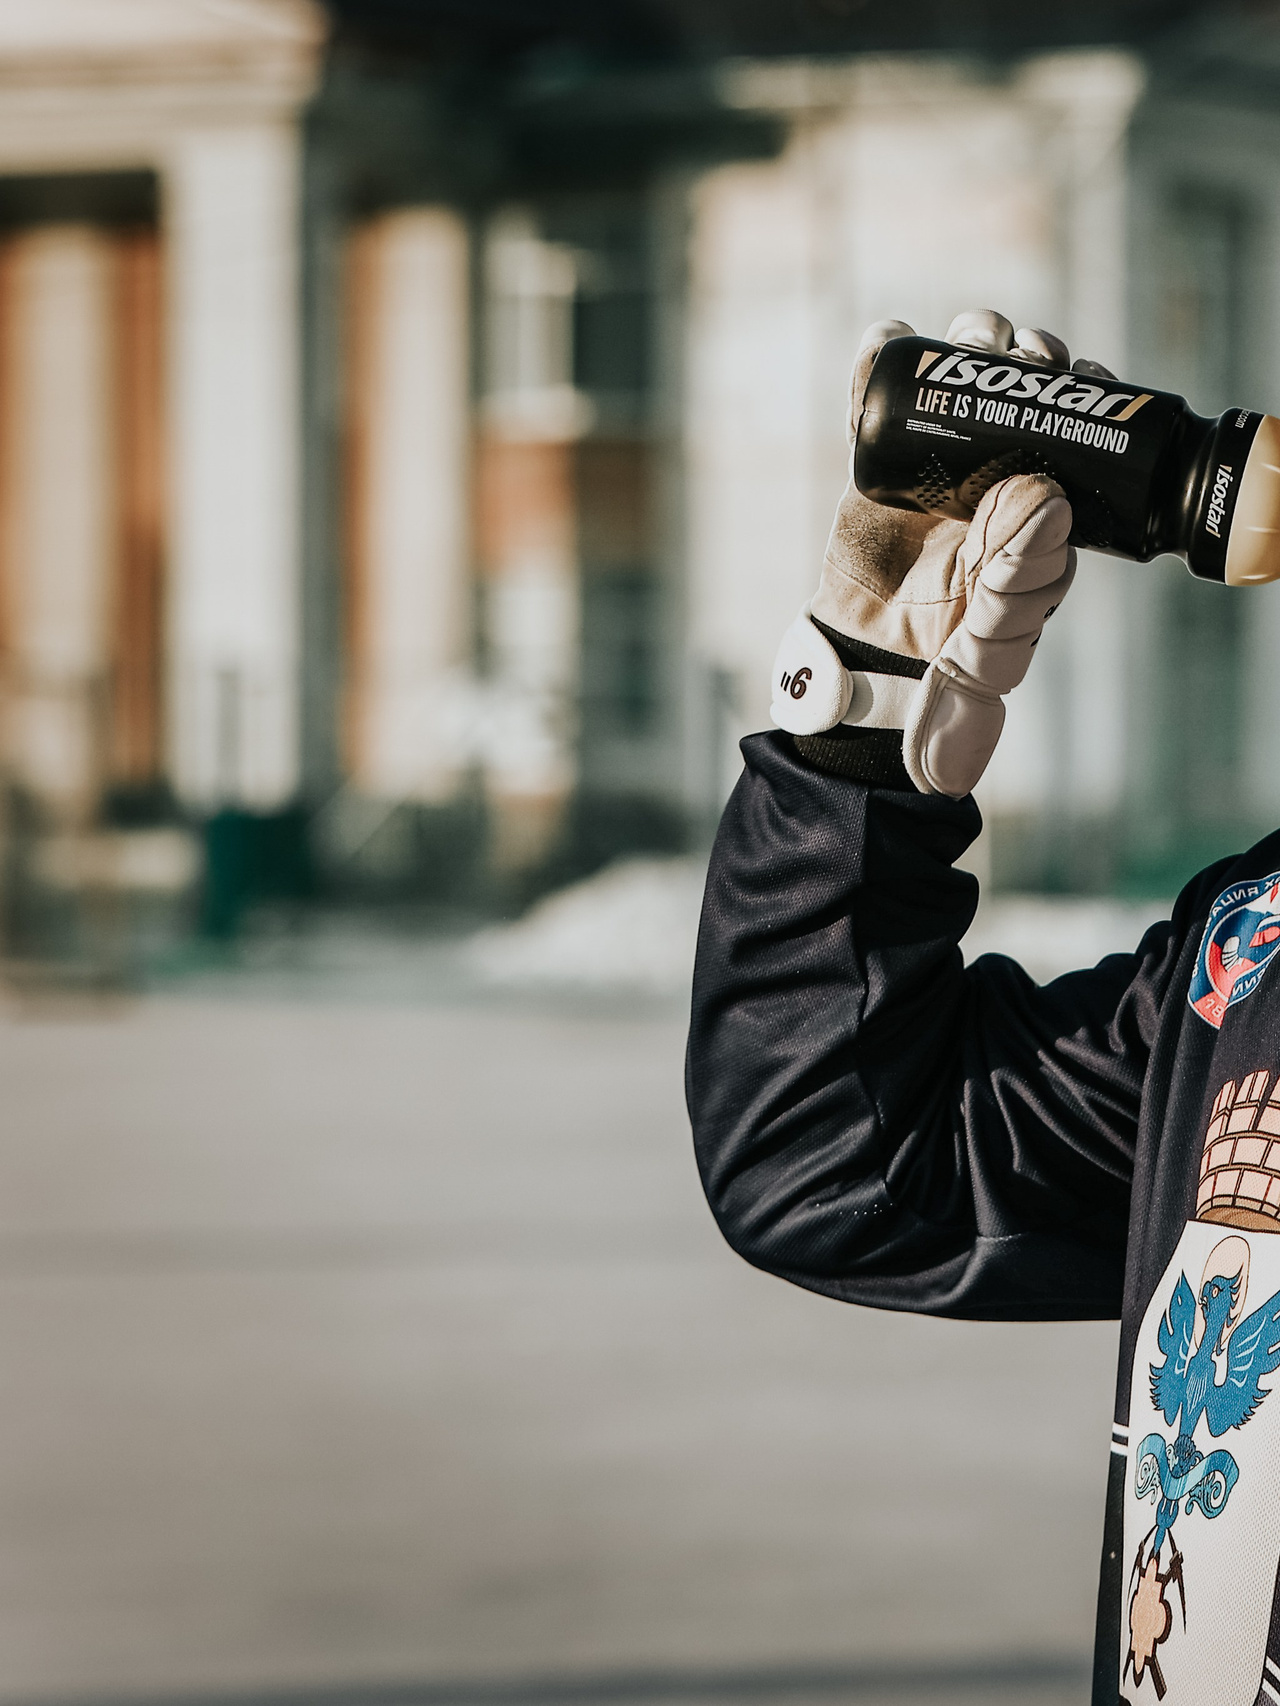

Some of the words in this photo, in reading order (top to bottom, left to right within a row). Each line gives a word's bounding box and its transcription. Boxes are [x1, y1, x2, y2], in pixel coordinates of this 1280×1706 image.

[924, 351, 1140, 420] isostar
[915, 387, 952, 415] LIFE
[952, 393, 972, 419] IS
[975, 396, 1019, 428] YOUR
[1019, 406, 1130, 454] PLAYGROUND
[1206, 467, 1234, 536] isostar
